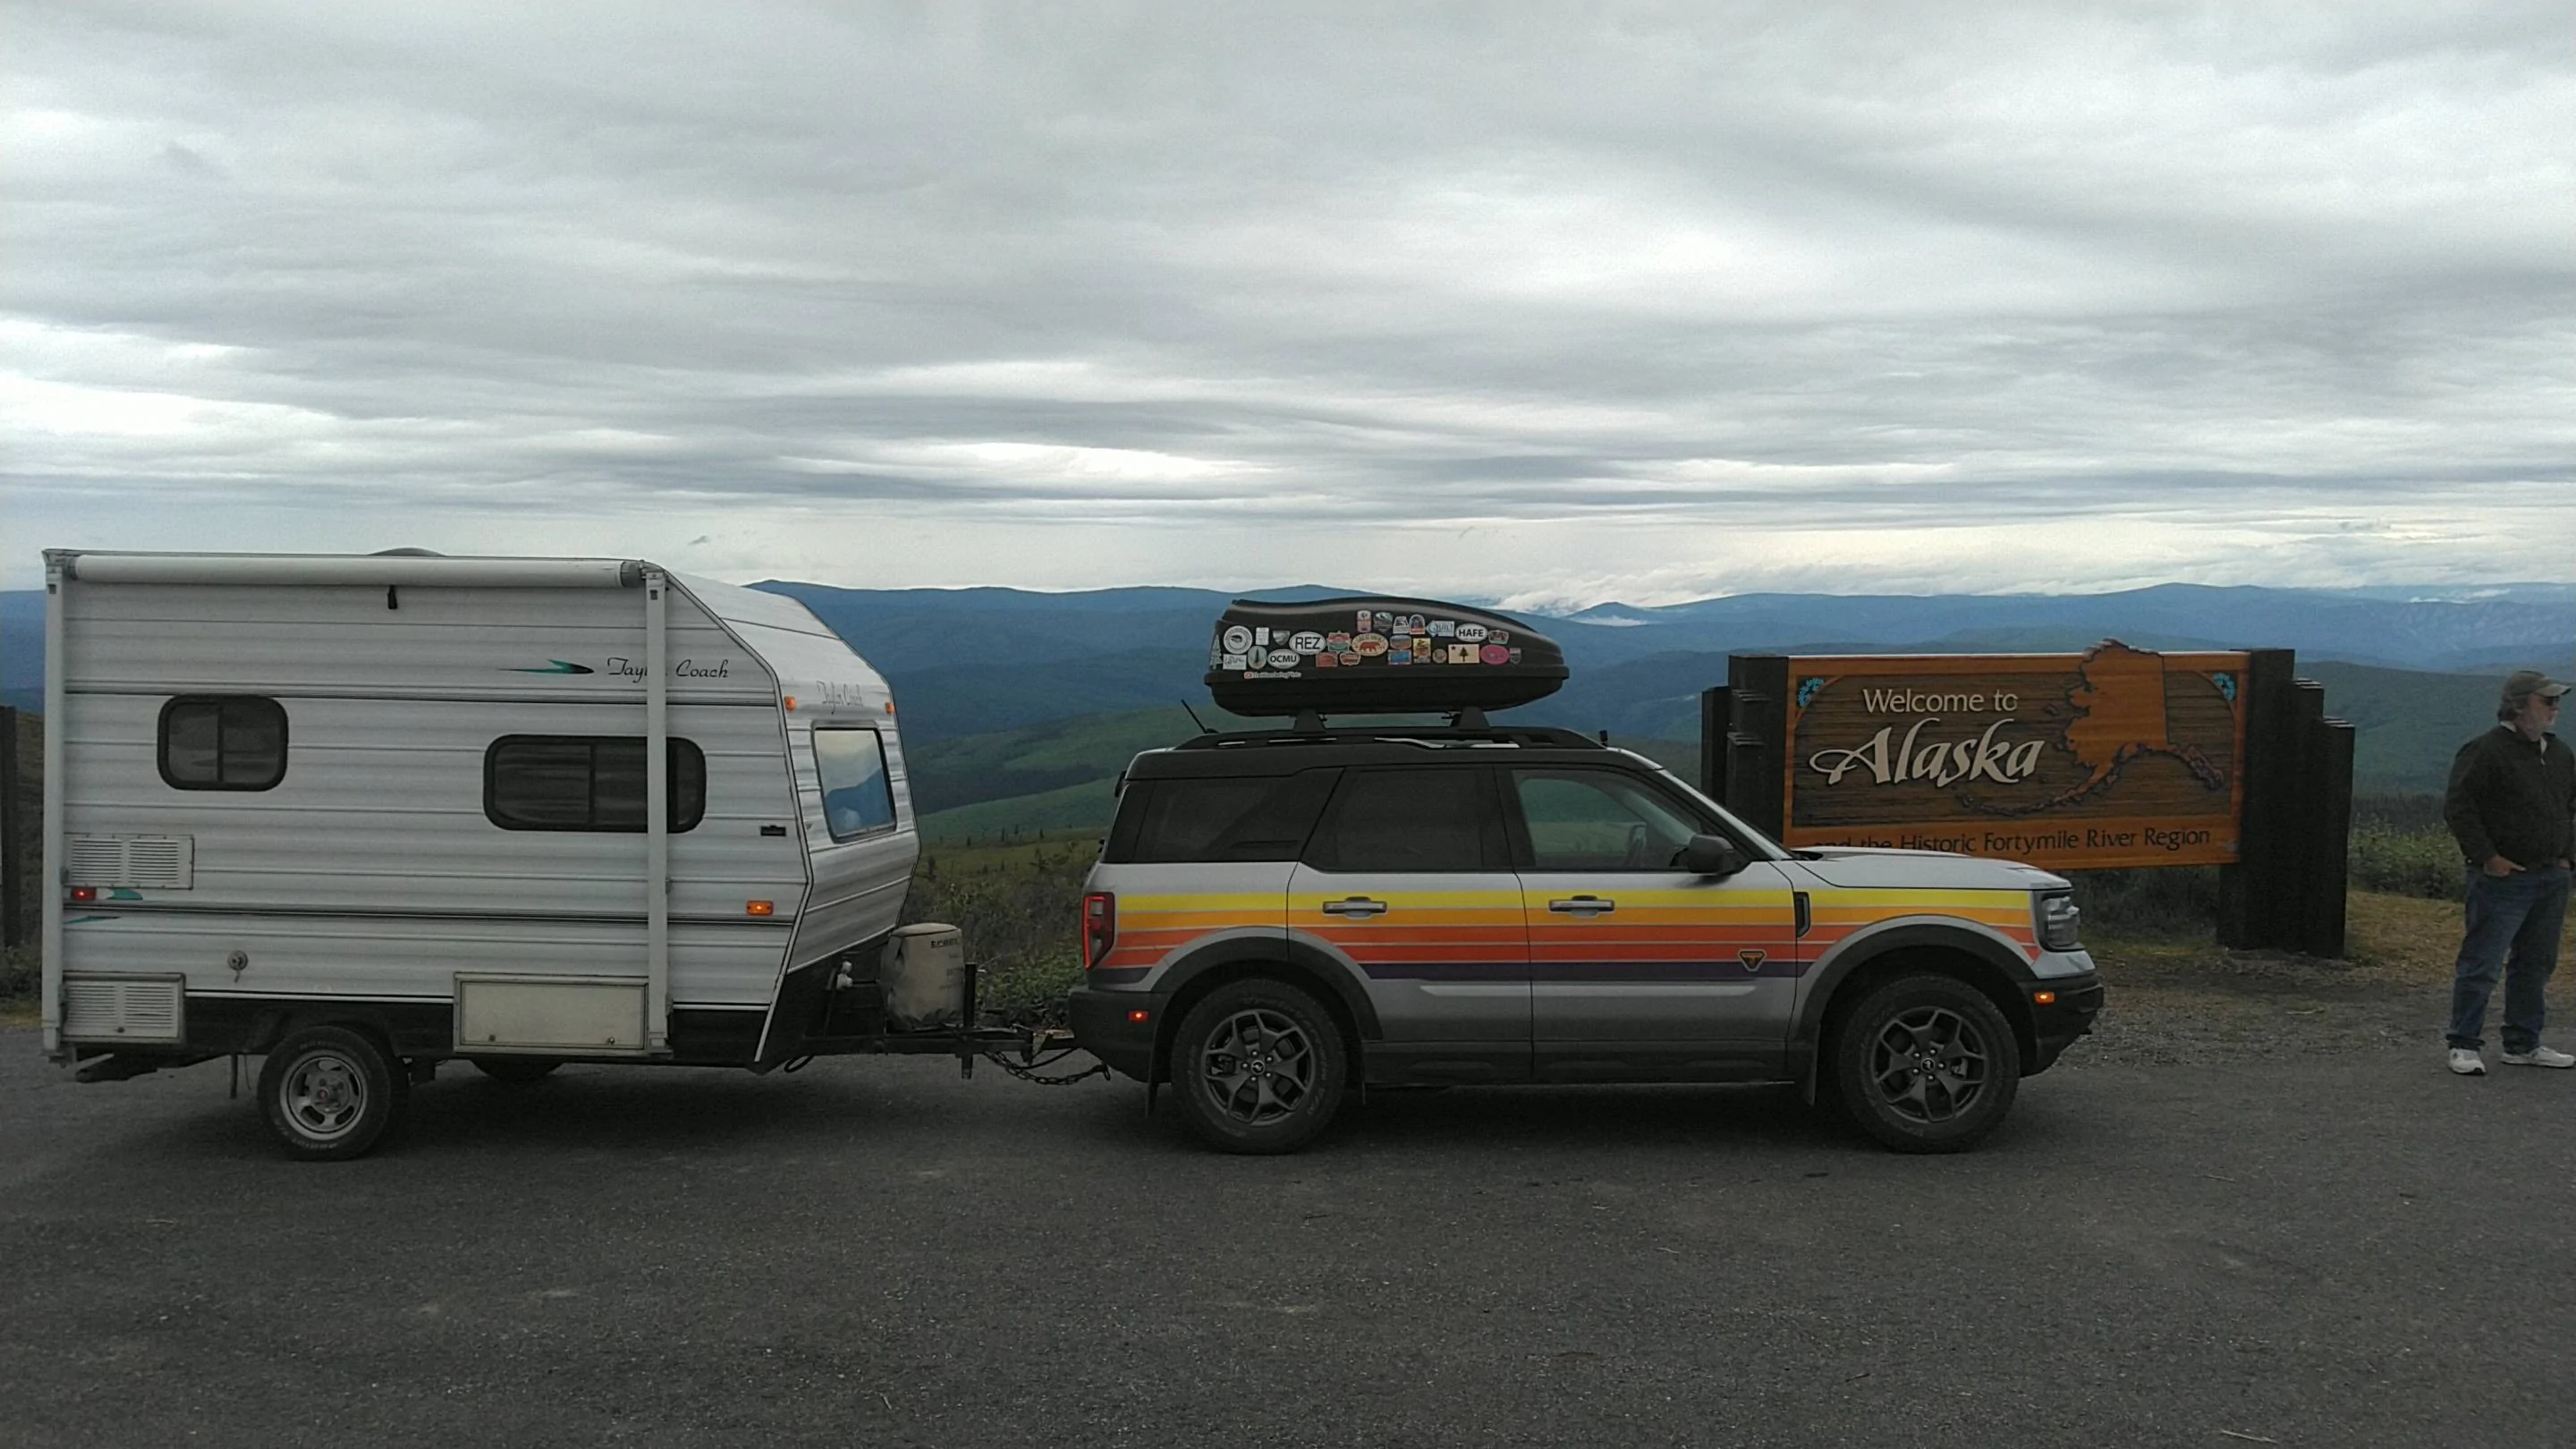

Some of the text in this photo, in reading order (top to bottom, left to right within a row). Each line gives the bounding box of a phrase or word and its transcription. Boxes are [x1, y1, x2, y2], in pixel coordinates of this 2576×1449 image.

[1295, 637, 1321, 649] REZ
[1459, 629, 1484, 637] HAFE
[607, 657, 729, 682] Tay Coach
[1270, 655, 1297, 663] OCMU
[1862, 688, 2019, 714] Welcome to
[1809, 717, 2046, 788] Alaska
[1901, 834, 1977, 852] Historic
[1984, 830, 2080, 855] Fortymile
[2086, 828, 2138, 848] River
[2144, 827, 2211, 851] Region
